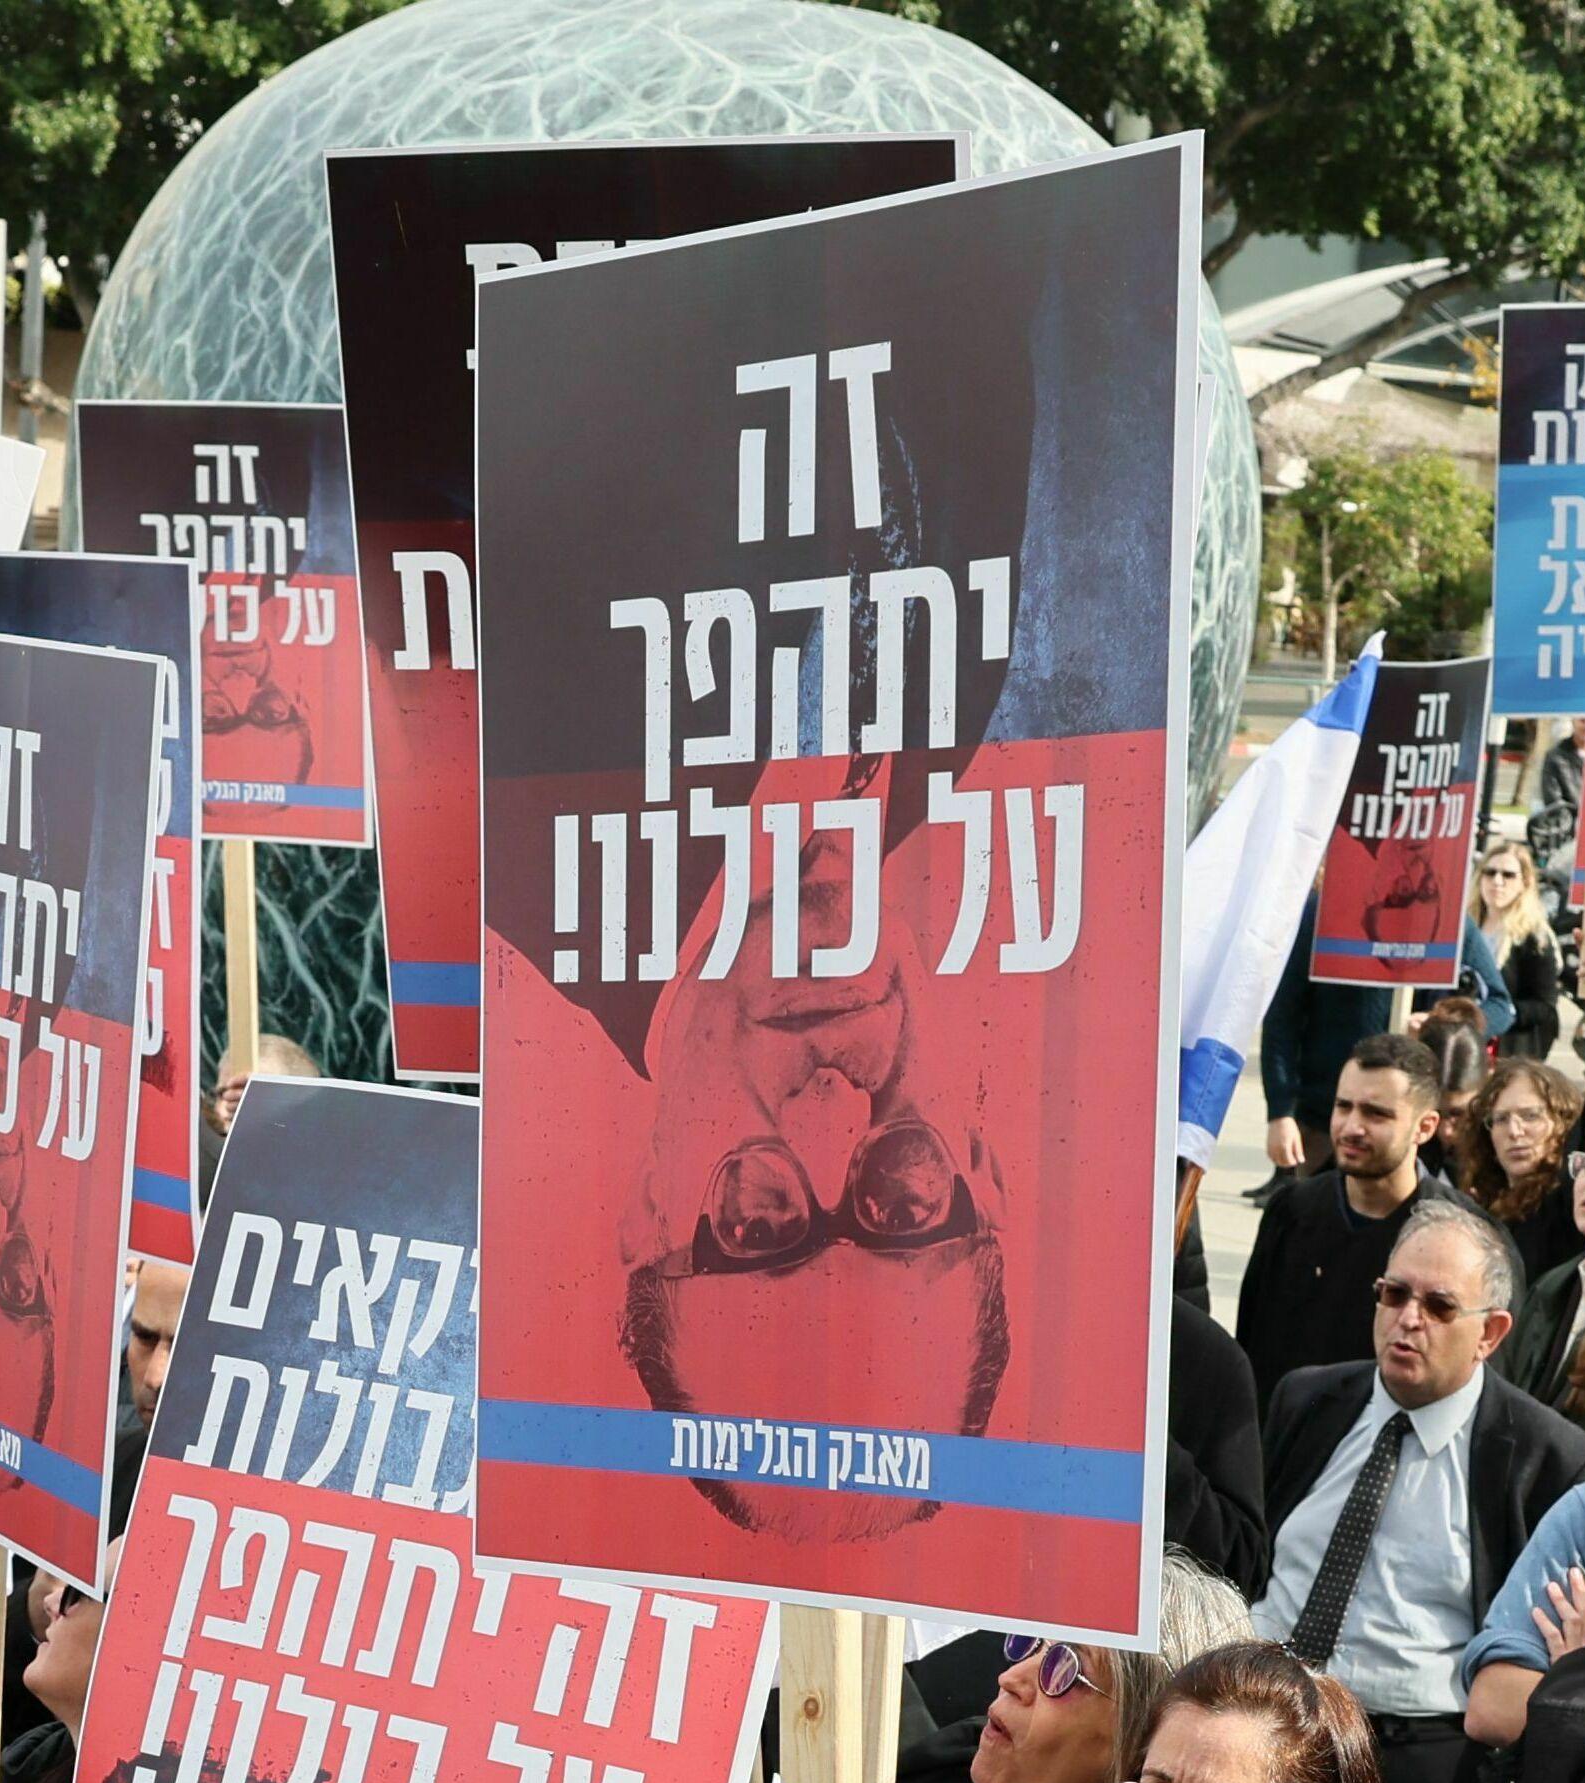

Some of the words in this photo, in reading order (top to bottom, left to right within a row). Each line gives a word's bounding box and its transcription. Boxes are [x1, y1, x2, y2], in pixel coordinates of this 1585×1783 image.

[193, 444, 259, 505] זה
[735, 341, 893, 543] זה
[274, 579, 335, 646] על
[610, 556, 1012, 803] יתהפך
[1378, 742, 1461, 796] יתהפך
[1415, 692, 1451, 738] זה
[553, 787, 882, 984] כולנו!
[927, 771, 1085, 977] על
[37, 1018, 102, 1162] על
[670, 1419, 817, 1479] הגלימות
[828, 1430, 930, 1491] מאבק
[162, 1492, 515, 1688] יתהפך
[532, 1578, 719, 1744] זה
